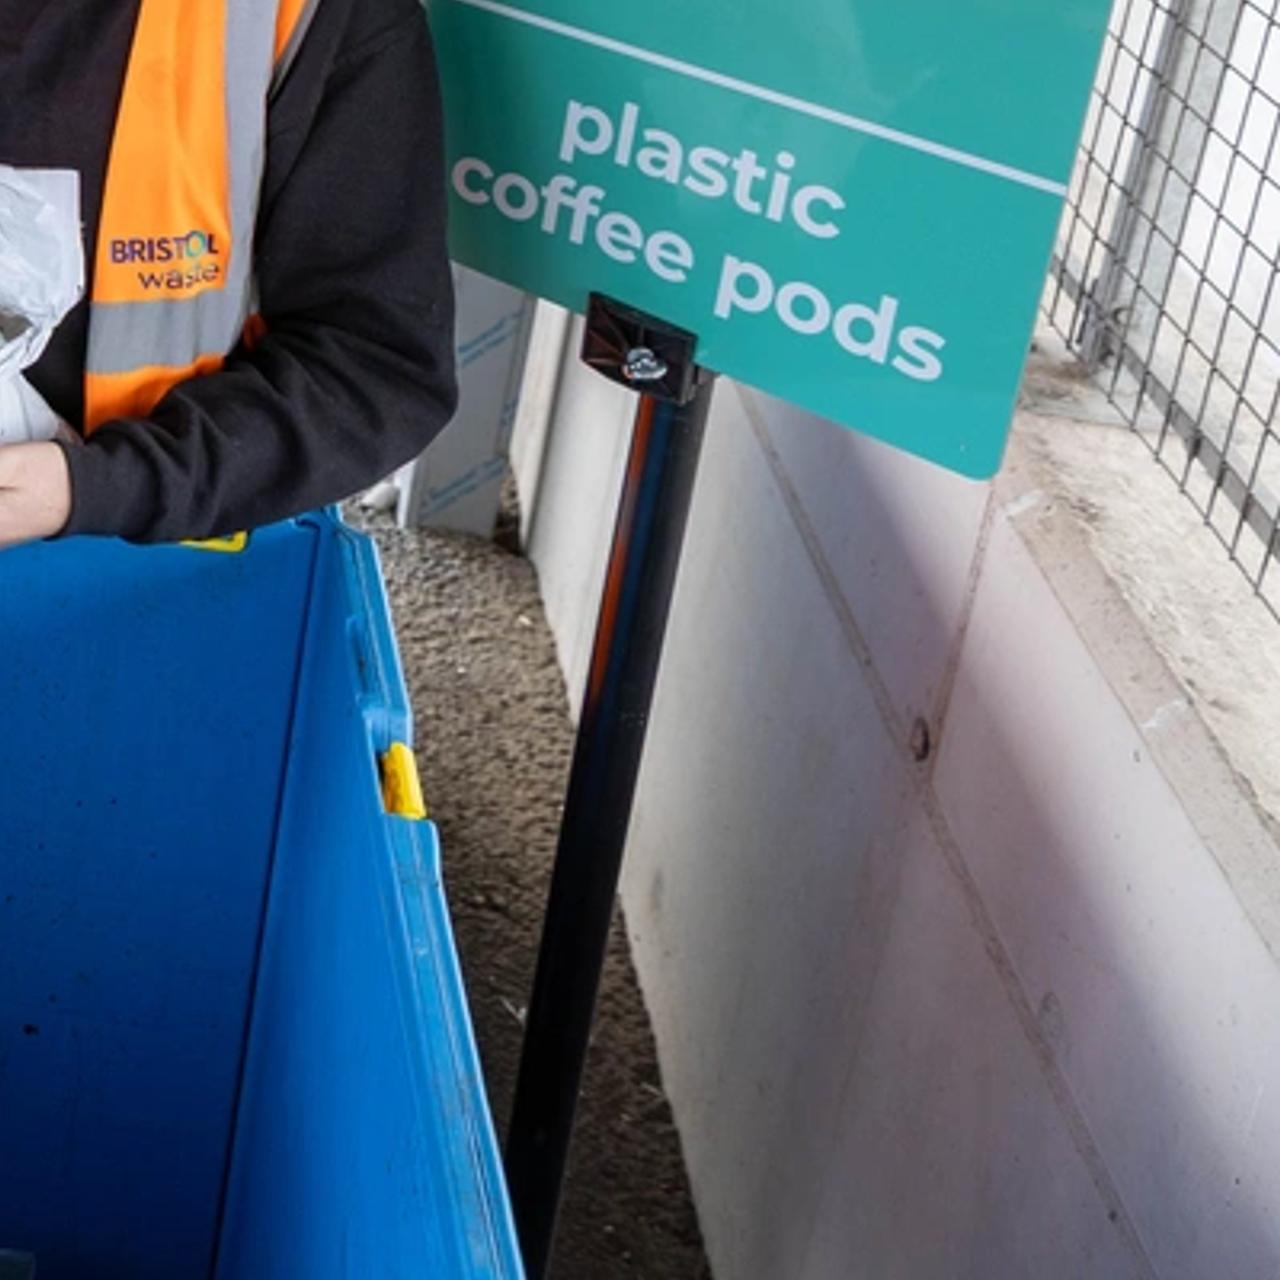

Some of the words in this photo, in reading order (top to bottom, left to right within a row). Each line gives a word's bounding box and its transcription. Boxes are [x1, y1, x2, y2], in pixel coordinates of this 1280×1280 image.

[559, 99, 847, 240] plastic
[110, 229, 220, 264] BRISTOL
[137, 263, 220, 290] waste
[450, 156, 695, 283] coffee
[712, 254, 946, 382] pods
